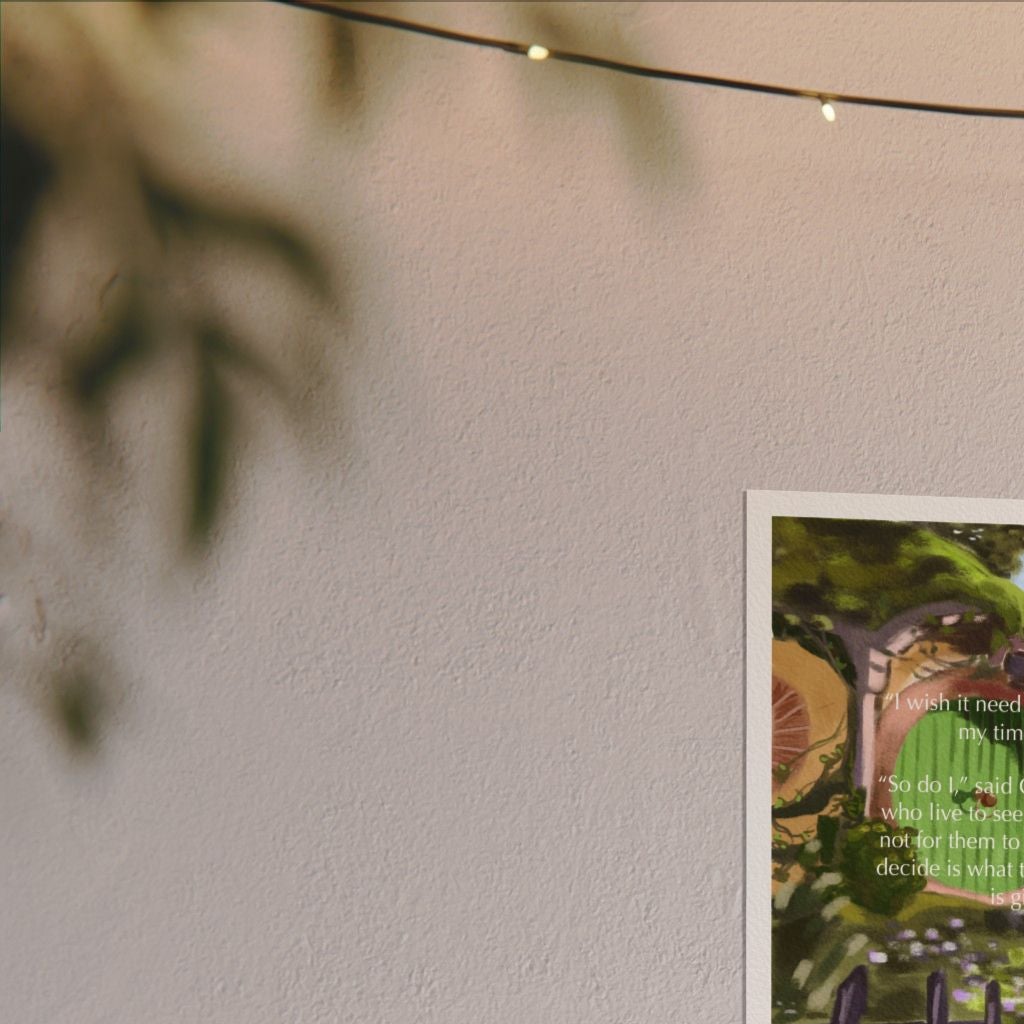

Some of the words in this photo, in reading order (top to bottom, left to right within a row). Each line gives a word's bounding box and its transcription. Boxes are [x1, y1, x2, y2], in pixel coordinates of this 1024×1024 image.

[907, 693, 950, 711] wish
[958, 694, 969, 711] it
[976, 694, 1021, 712] need
[959, 727, 986, 745] my
[879, 775, 911, 793] “So
[917, 775, 942, 793] do
[975, 776, 1012, 794] said
[882, 802, 922, 820] who
[930, 802, 962, 821] live
[969, 807, 987, 821] to
[993, 809, 1023, 822] see
[880, 834, 910, 848] not
[917, 830, 942, 848] for
[949, 830, 995, 849] them
[1002, 835, 1020, 850] to
[876, 857, 940, 877] decide
[947, 859, 961, 877] is
[967, 858, 1012, 877] what
[991, 888, 1004, 905] is
